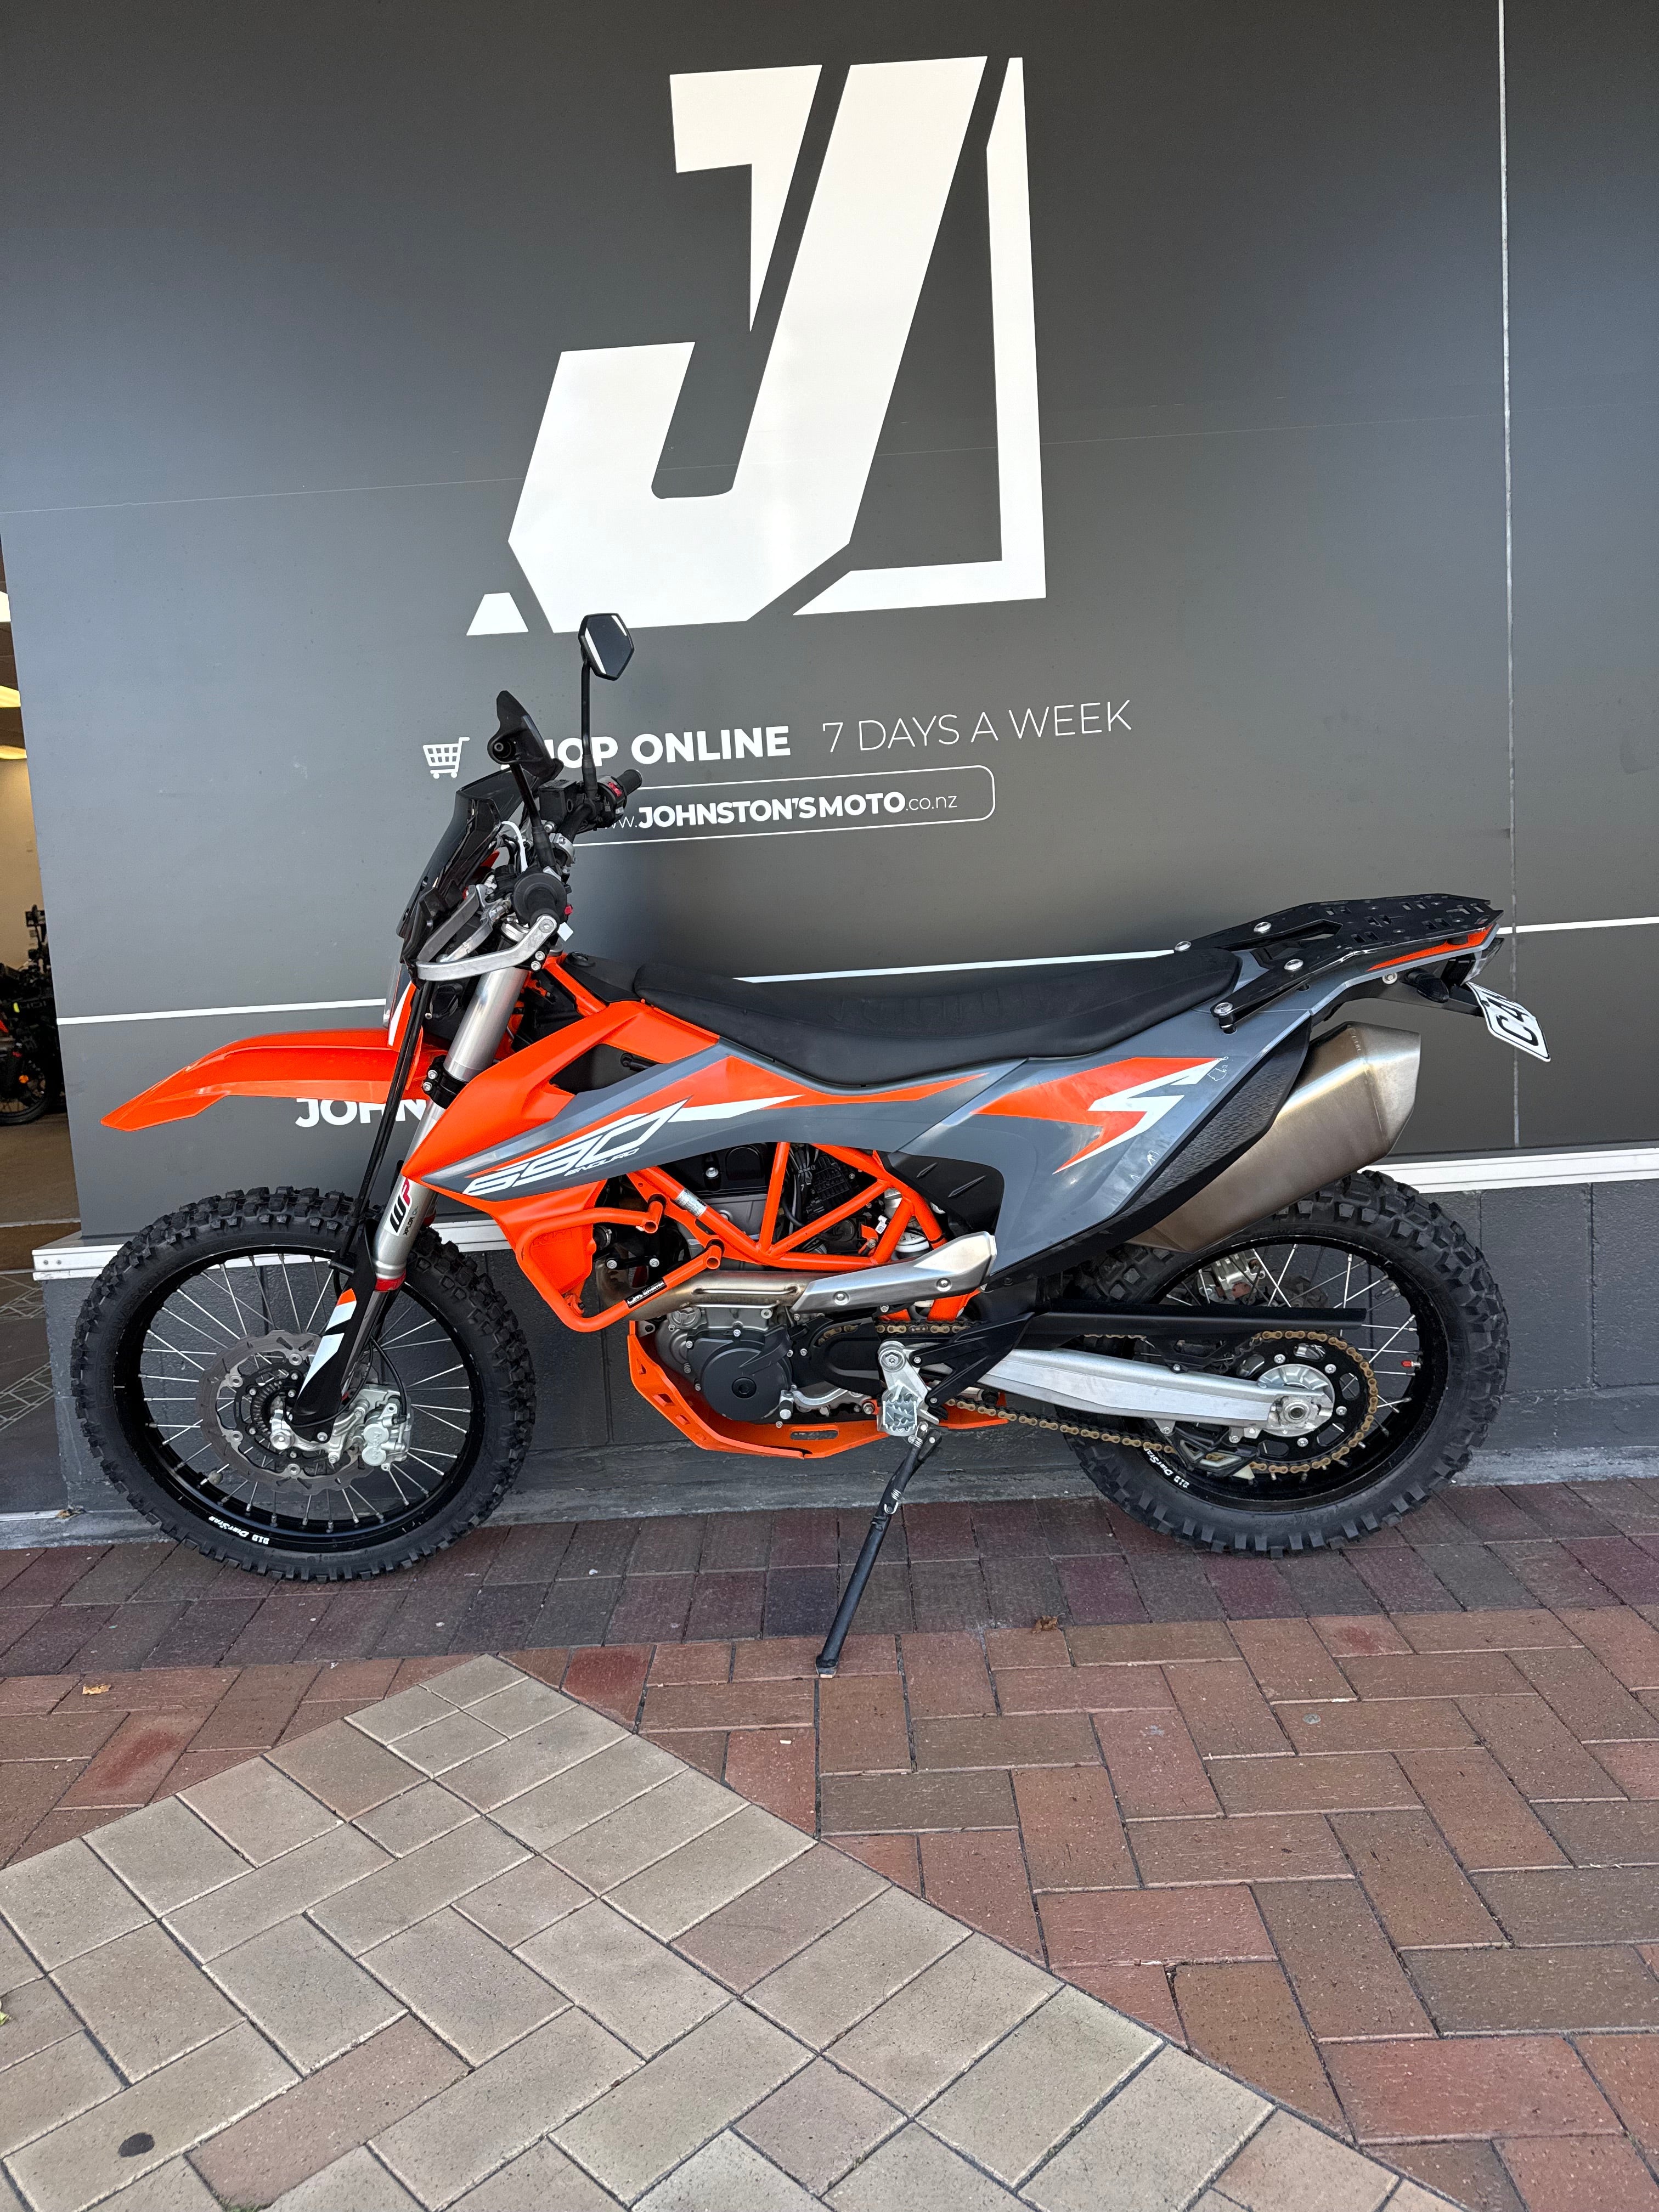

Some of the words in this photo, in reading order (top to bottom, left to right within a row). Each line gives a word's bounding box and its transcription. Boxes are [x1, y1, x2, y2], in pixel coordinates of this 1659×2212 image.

[500, 736, 618, 770] OP
[631, 725, 791, 765] ONLINE
[822, 721, 844, 753] 7
[858, 714, 960, 751] DAYS
[970, 711, 999, 743] A
[1008, 699, 1132, 739] WEEK
[462, 1098, 689, 1197] 690
[563, 1147, 640, 1177] ENDURO
[390, 1178, 410, 1234] WP
